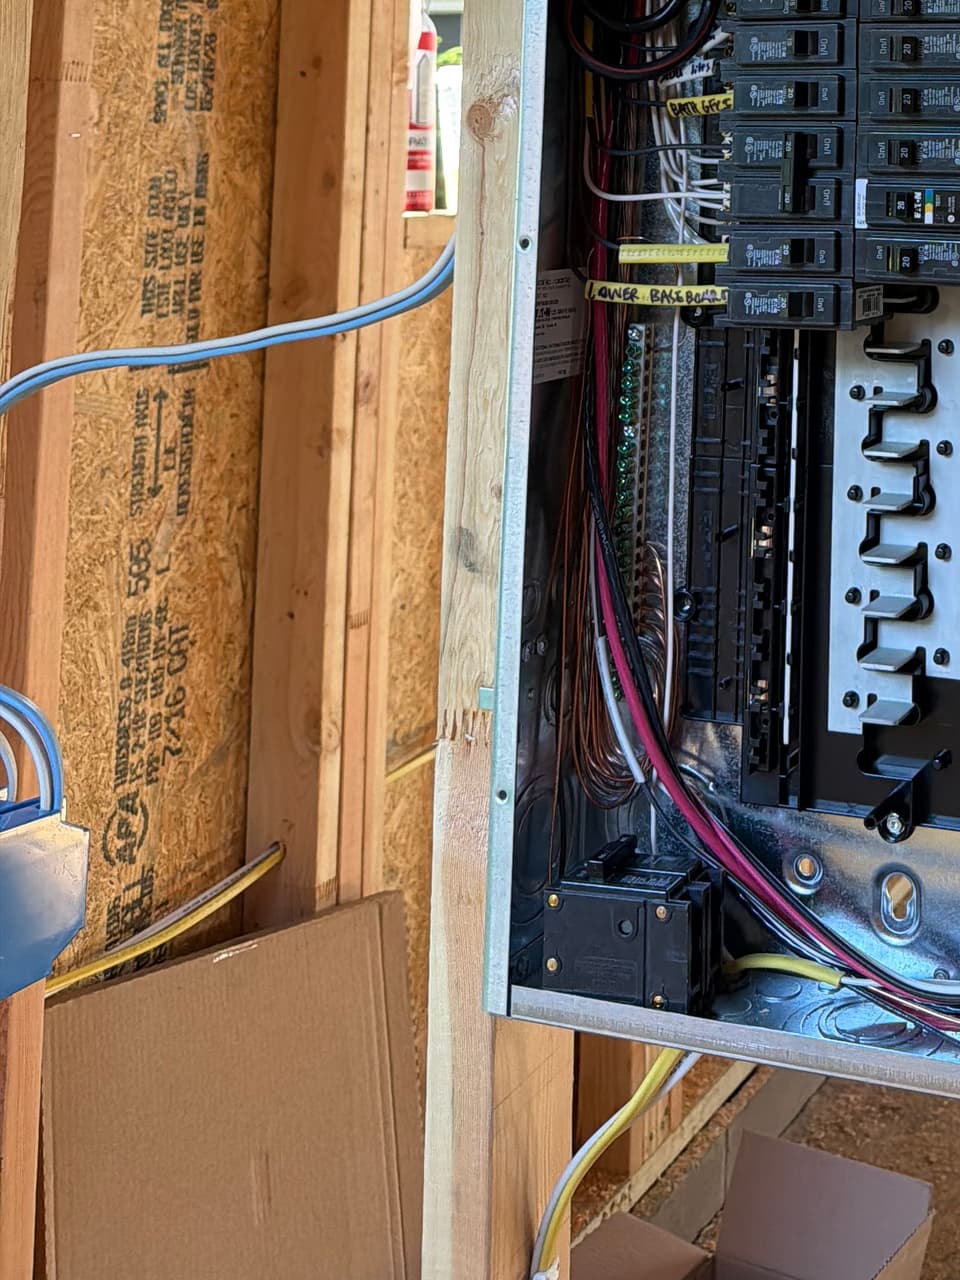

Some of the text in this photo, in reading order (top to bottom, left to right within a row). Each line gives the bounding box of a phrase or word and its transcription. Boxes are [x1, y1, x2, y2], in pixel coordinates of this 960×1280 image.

[904, 0, 913, 11] 20
[903, 43, 912, 55] 20
[900, 147, 909, 158] 20
[901, 256, 911, 268] 20
[587, 281, 640, 303] LOWER
[165, 624, 189, 677] CAT
